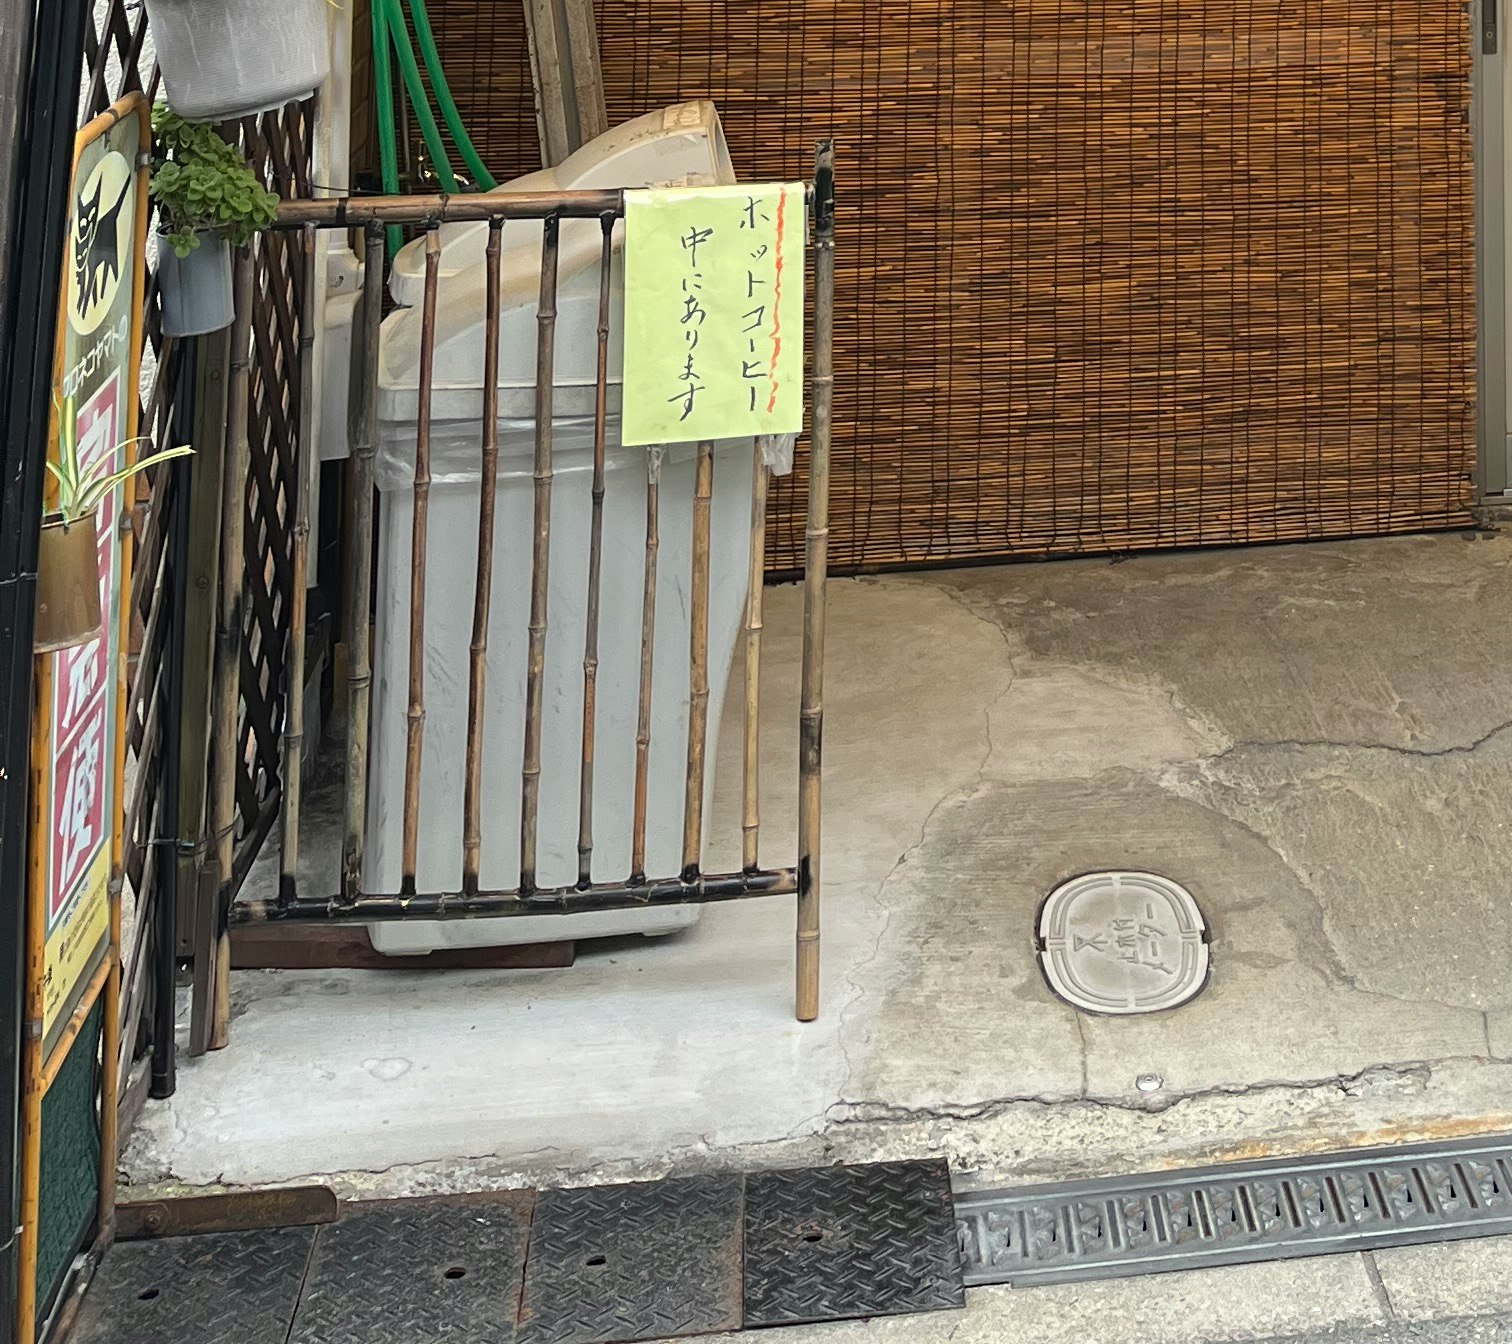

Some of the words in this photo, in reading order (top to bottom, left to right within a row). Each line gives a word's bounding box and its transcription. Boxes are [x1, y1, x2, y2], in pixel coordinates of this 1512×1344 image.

[667, 226, 714, 422] 中にあります
[739, 196, 770, 412] ホットコーヒー
